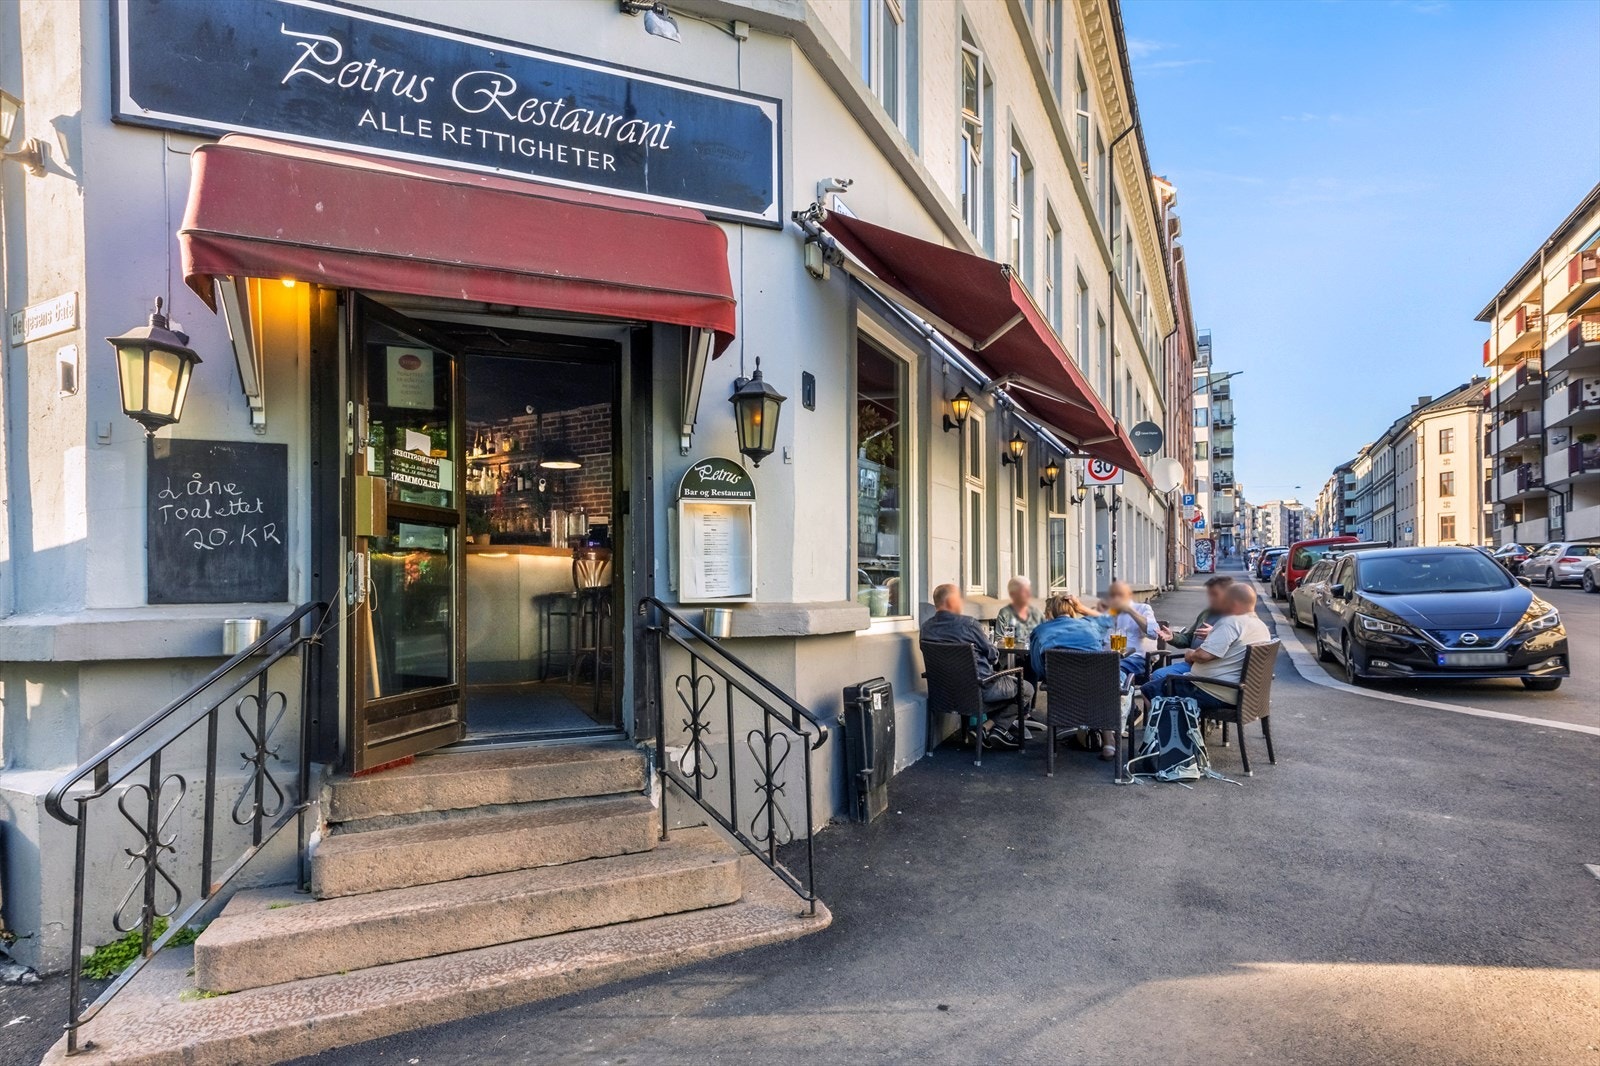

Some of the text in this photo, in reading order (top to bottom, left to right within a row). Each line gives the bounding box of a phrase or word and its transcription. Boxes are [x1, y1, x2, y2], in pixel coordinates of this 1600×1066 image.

[280, 22, 676, 150] Petrus Restaurant
[358, 108, 617, 172] ALLE RETTIGHETER
[694, 464, 742, 484] Petrus
[1094, 460, 1113, 473] 30
[158, 472, 244, 499] Låne
[684, 488, 698, 496] Bar
[711, 488, 752, 497] Restaurant
[158, 497, 264, 525] Toalettet
